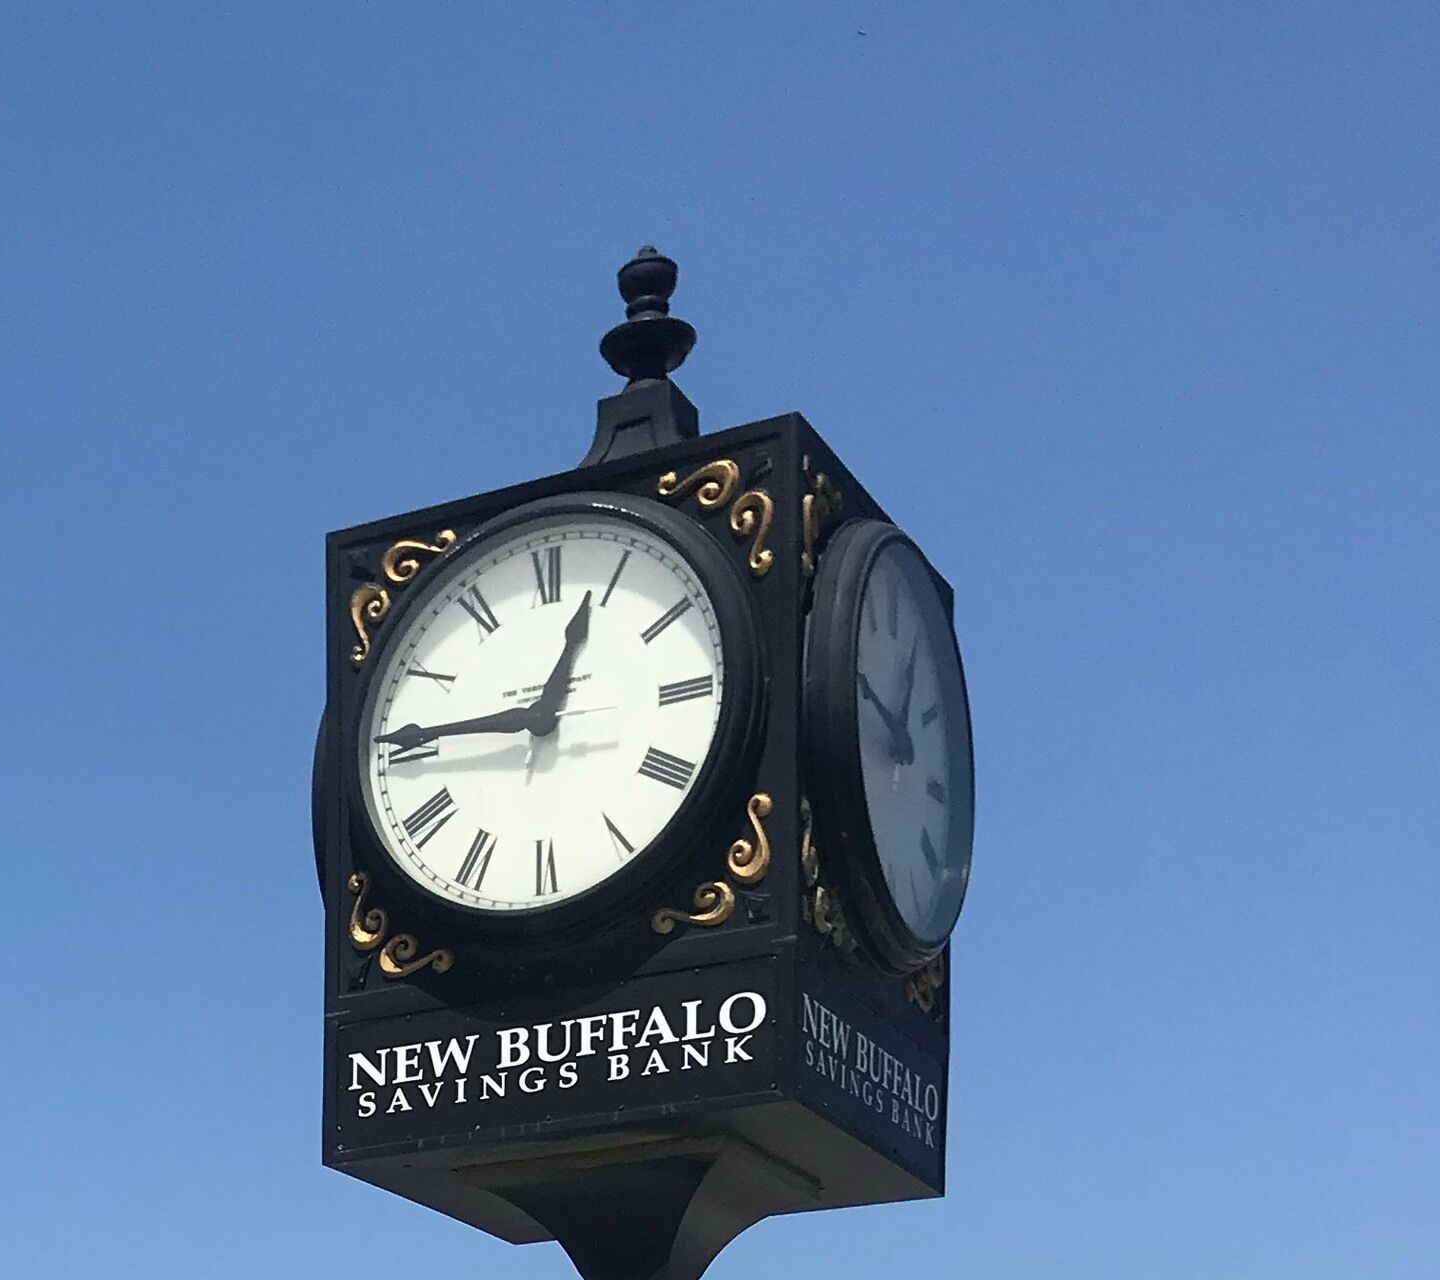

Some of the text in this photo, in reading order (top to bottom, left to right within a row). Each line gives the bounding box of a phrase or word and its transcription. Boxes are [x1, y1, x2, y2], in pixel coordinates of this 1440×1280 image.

[530, 546, 563, 609] XII
[458, 583, 501, 645] XI
[640, 595, 694, 645] II
[658, 673, 714, 707] III
[453, 827, 498, 893] VII
[534, 837, 562, 897] VI
[347, 991, 768, 1091] NEW BUFFALO
[801, 992, 939, 1122] NEW BUFFALO
[357, 1034, 755, 1118] SAVINGS BANK
[805, 1040, 935, 1149] SAVINGS BANK
